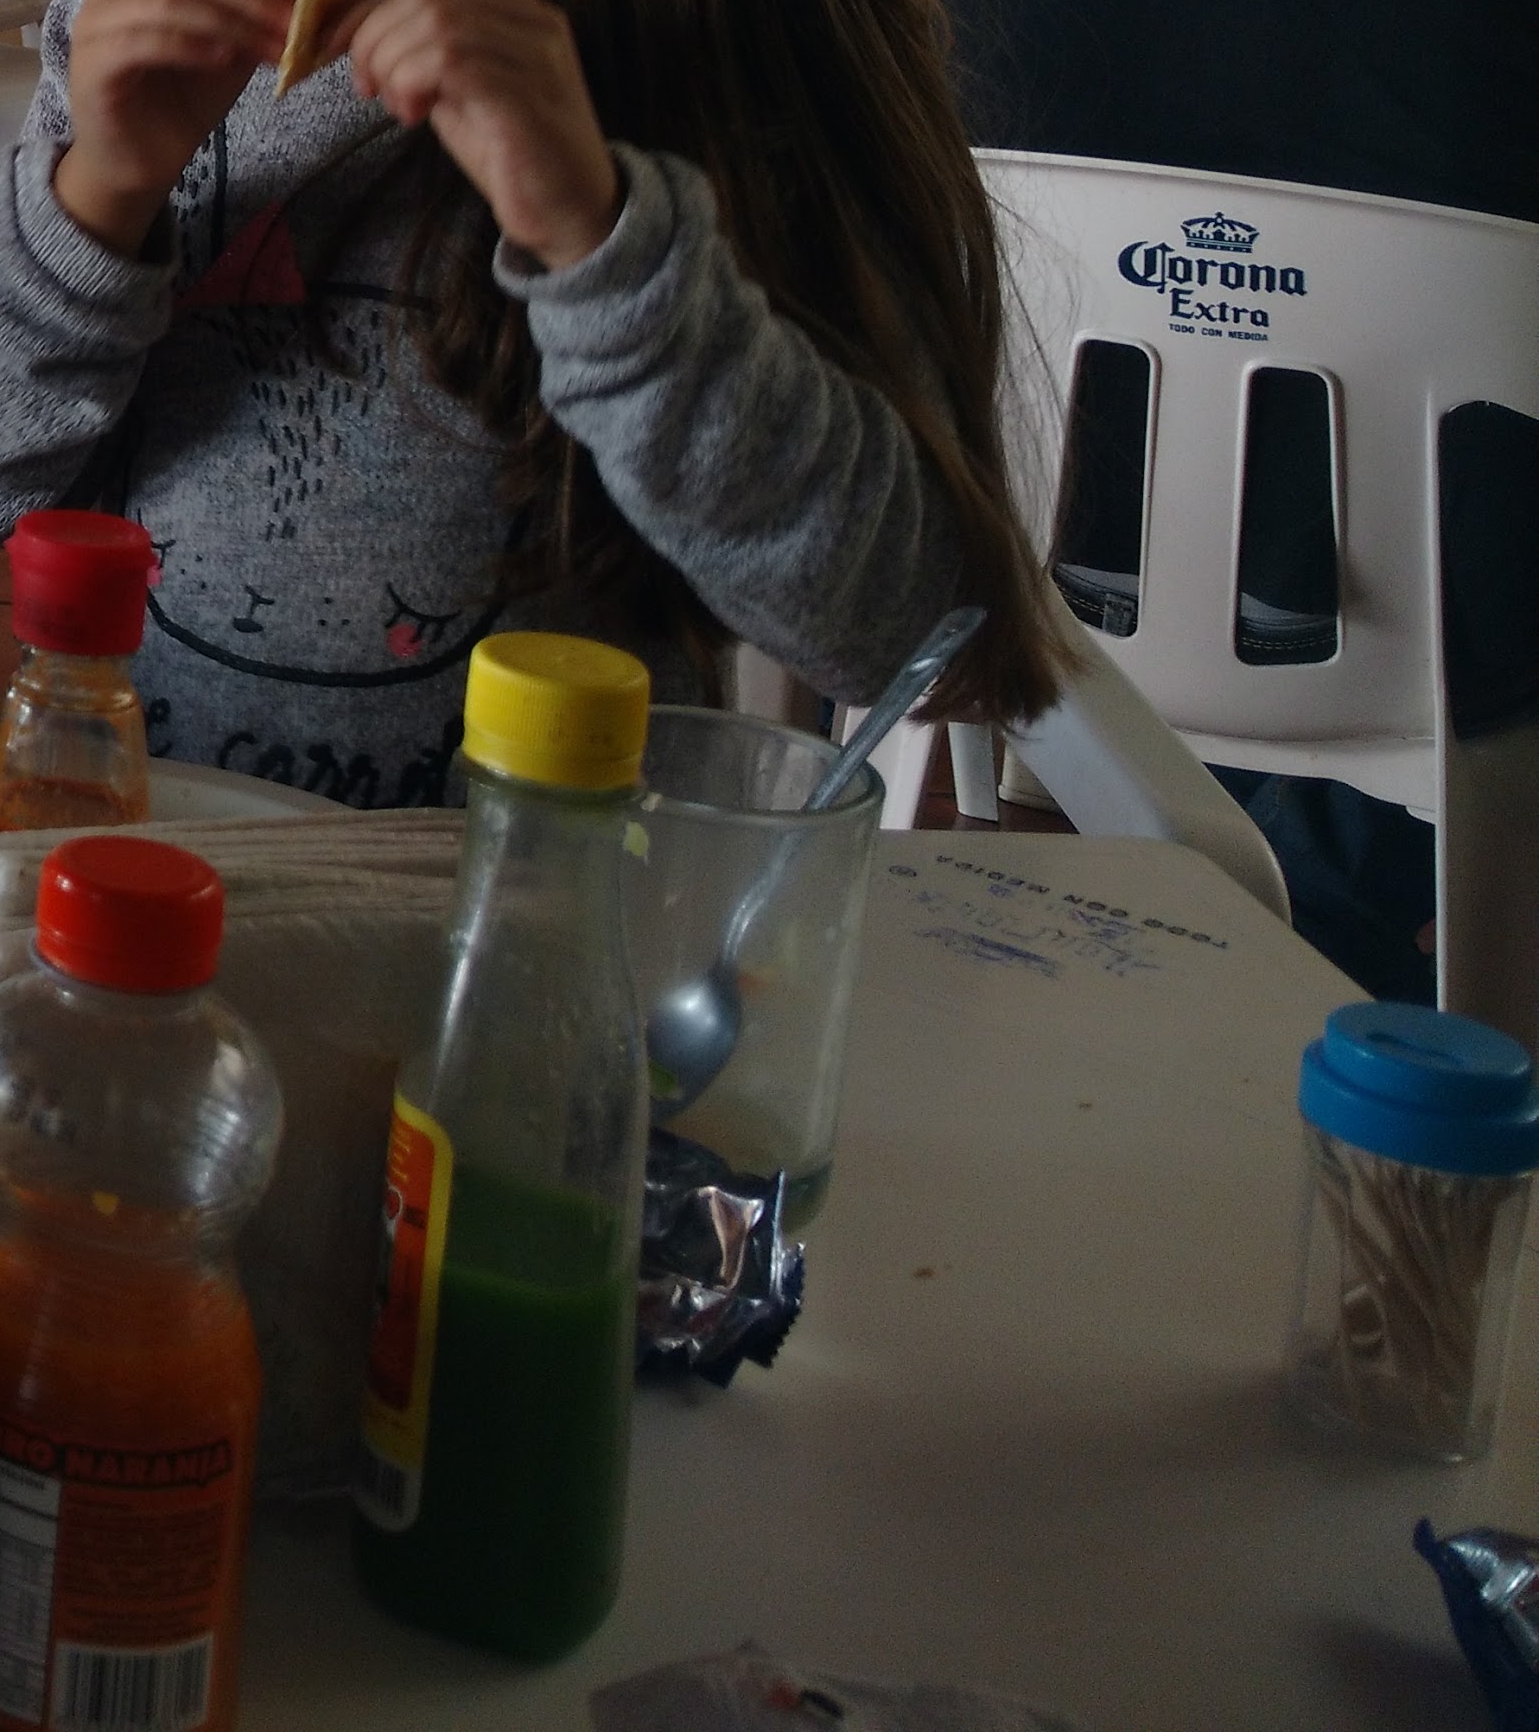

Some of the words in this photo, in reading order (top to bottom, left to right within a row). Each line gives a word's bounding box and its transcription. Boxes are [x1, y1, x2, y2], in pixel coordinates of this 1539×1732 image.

[1117, 240, 1308, 297] Corona
[1169, 287, 1270, 328] Extra
[1168, 323, 1196, 335] TODO
[1201, 327, 1223, 338] CON
[1228, 330, 1269, 342] MEDIDA
